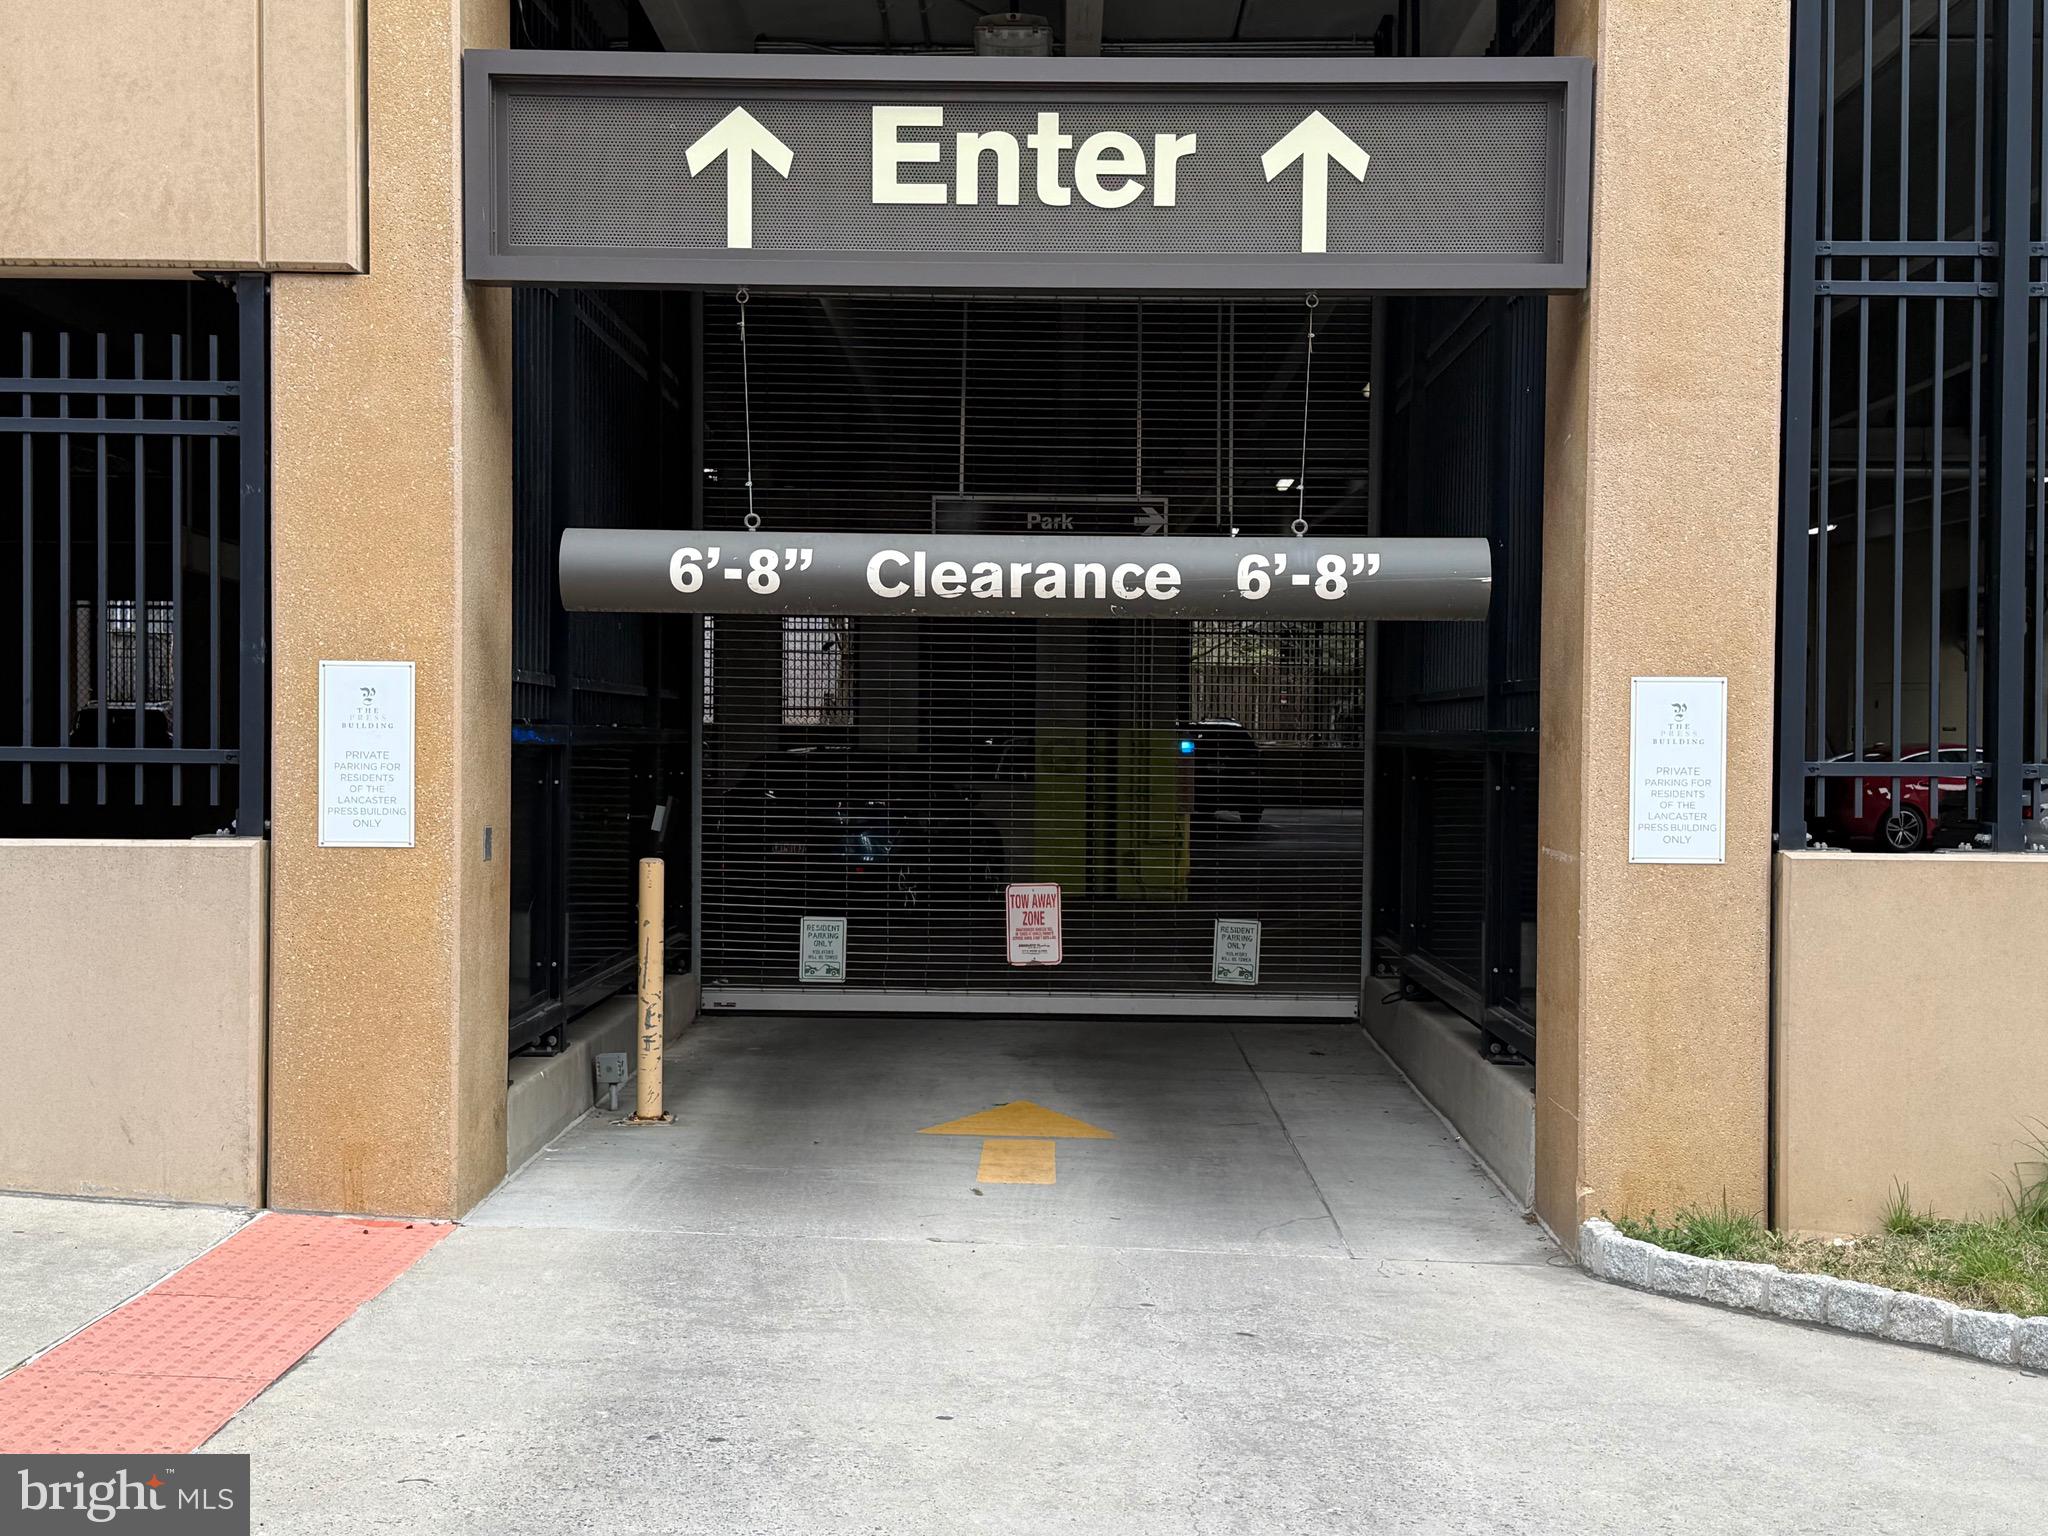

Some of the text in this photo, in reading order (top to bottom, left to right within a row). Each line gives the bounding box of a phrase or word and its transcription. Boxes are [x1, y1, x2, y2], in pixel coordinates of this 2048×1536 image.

[872, 106, 1196, 209] Enter
[1028, 512, 1074, 529] Park
[866, 550, 1182, 600] Clearance
[346, 750, 389, 760] PRIVATE
[334, 762, 400, 771] PARKING FOR
[1656, 767, 1700, 776] PRIVATE
[340, 774, 394, 782] RESIDENTS
[1645, 779, 1711, 787] PARKING FOR
[349, 785, 385, 793] OF THE
[1651, 790, 1705, 798] RESIDENTS
[337, 796, 396, 804] LANCASTER
[328, 807, 407, 816] PRESS BUILDING
[1648, 812, 1707, 821] LANCASTER
[352, 818, 382, 828] ONLY
[1638, 824, 1717, 832] PRESS BUILDING
[1663, 835, 1692, 844] ONLY
[1010, 894, 1056, 908] TOW AWAY
[1022, 911, 1045, 925] ZONE
[1222, 934, 1253, 942] PARKING
